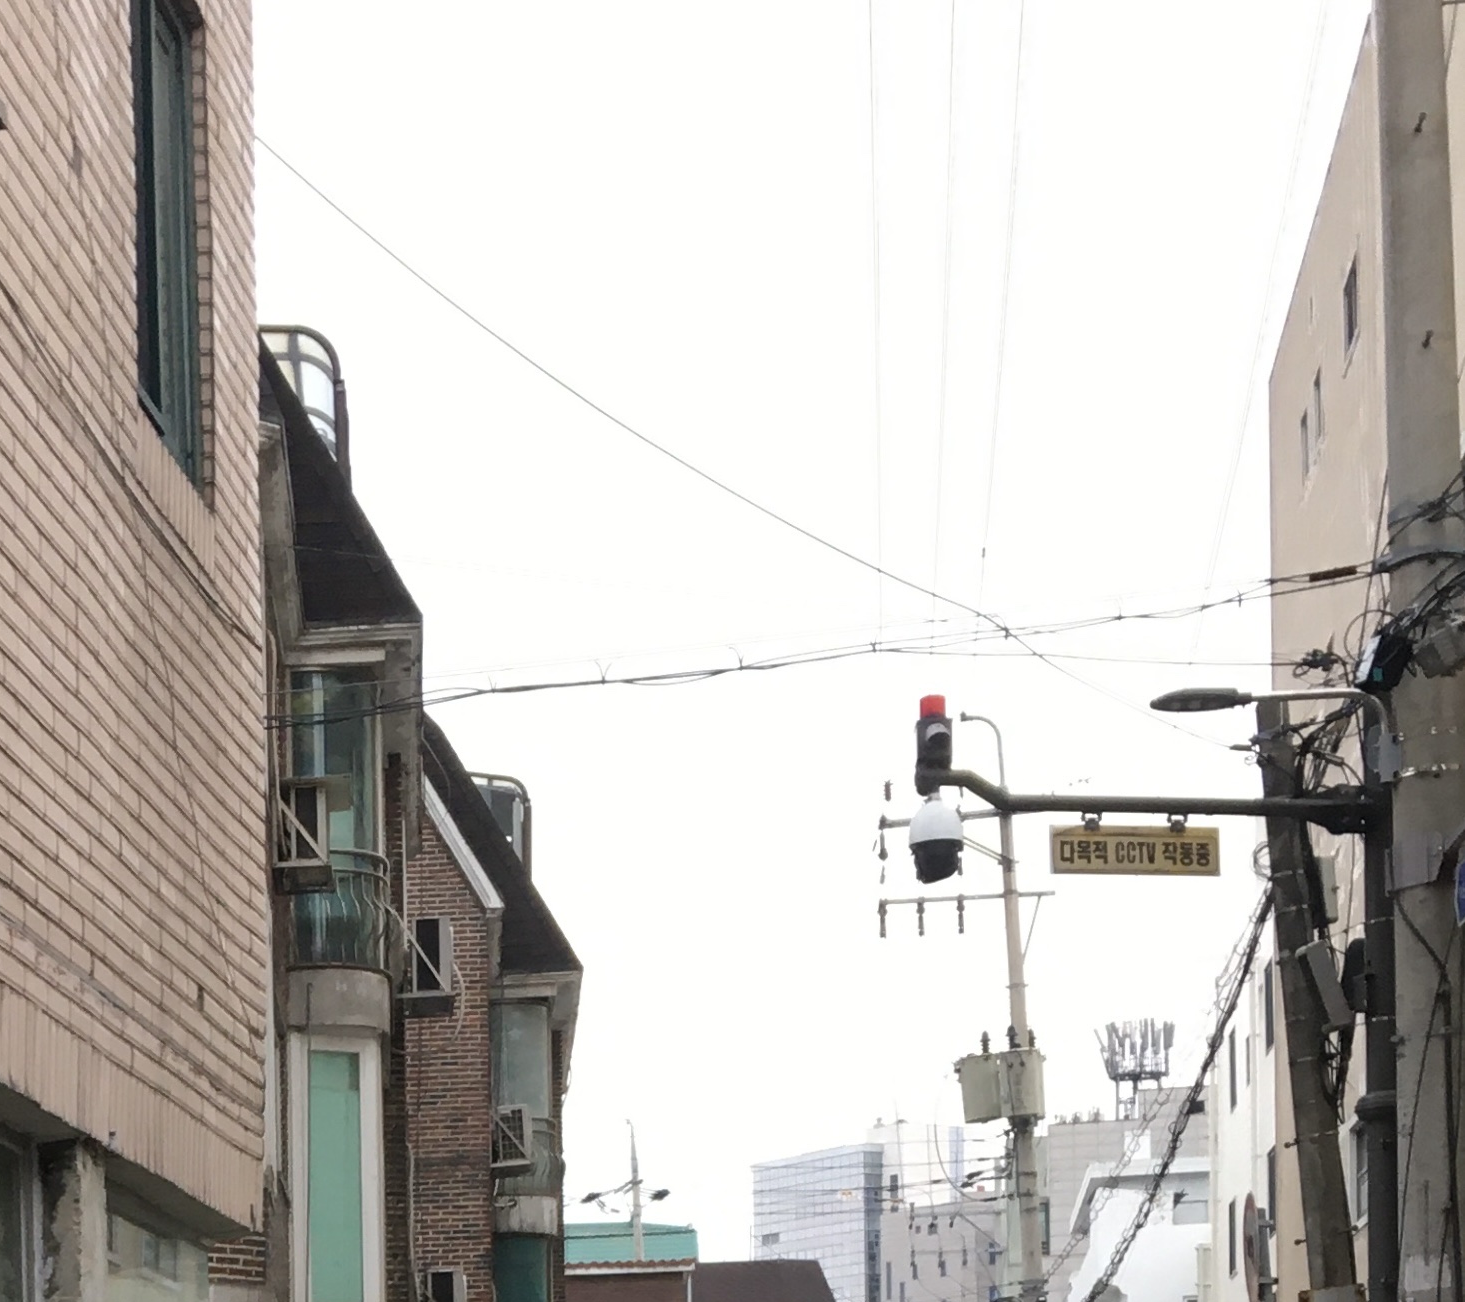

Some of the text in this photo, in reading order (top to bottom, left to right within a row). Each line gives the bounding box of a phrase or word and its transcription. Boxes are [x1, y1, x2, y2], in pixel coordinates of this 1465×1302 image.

[1060, 839, 1210, 867] 다목적 CCTV 작동중
